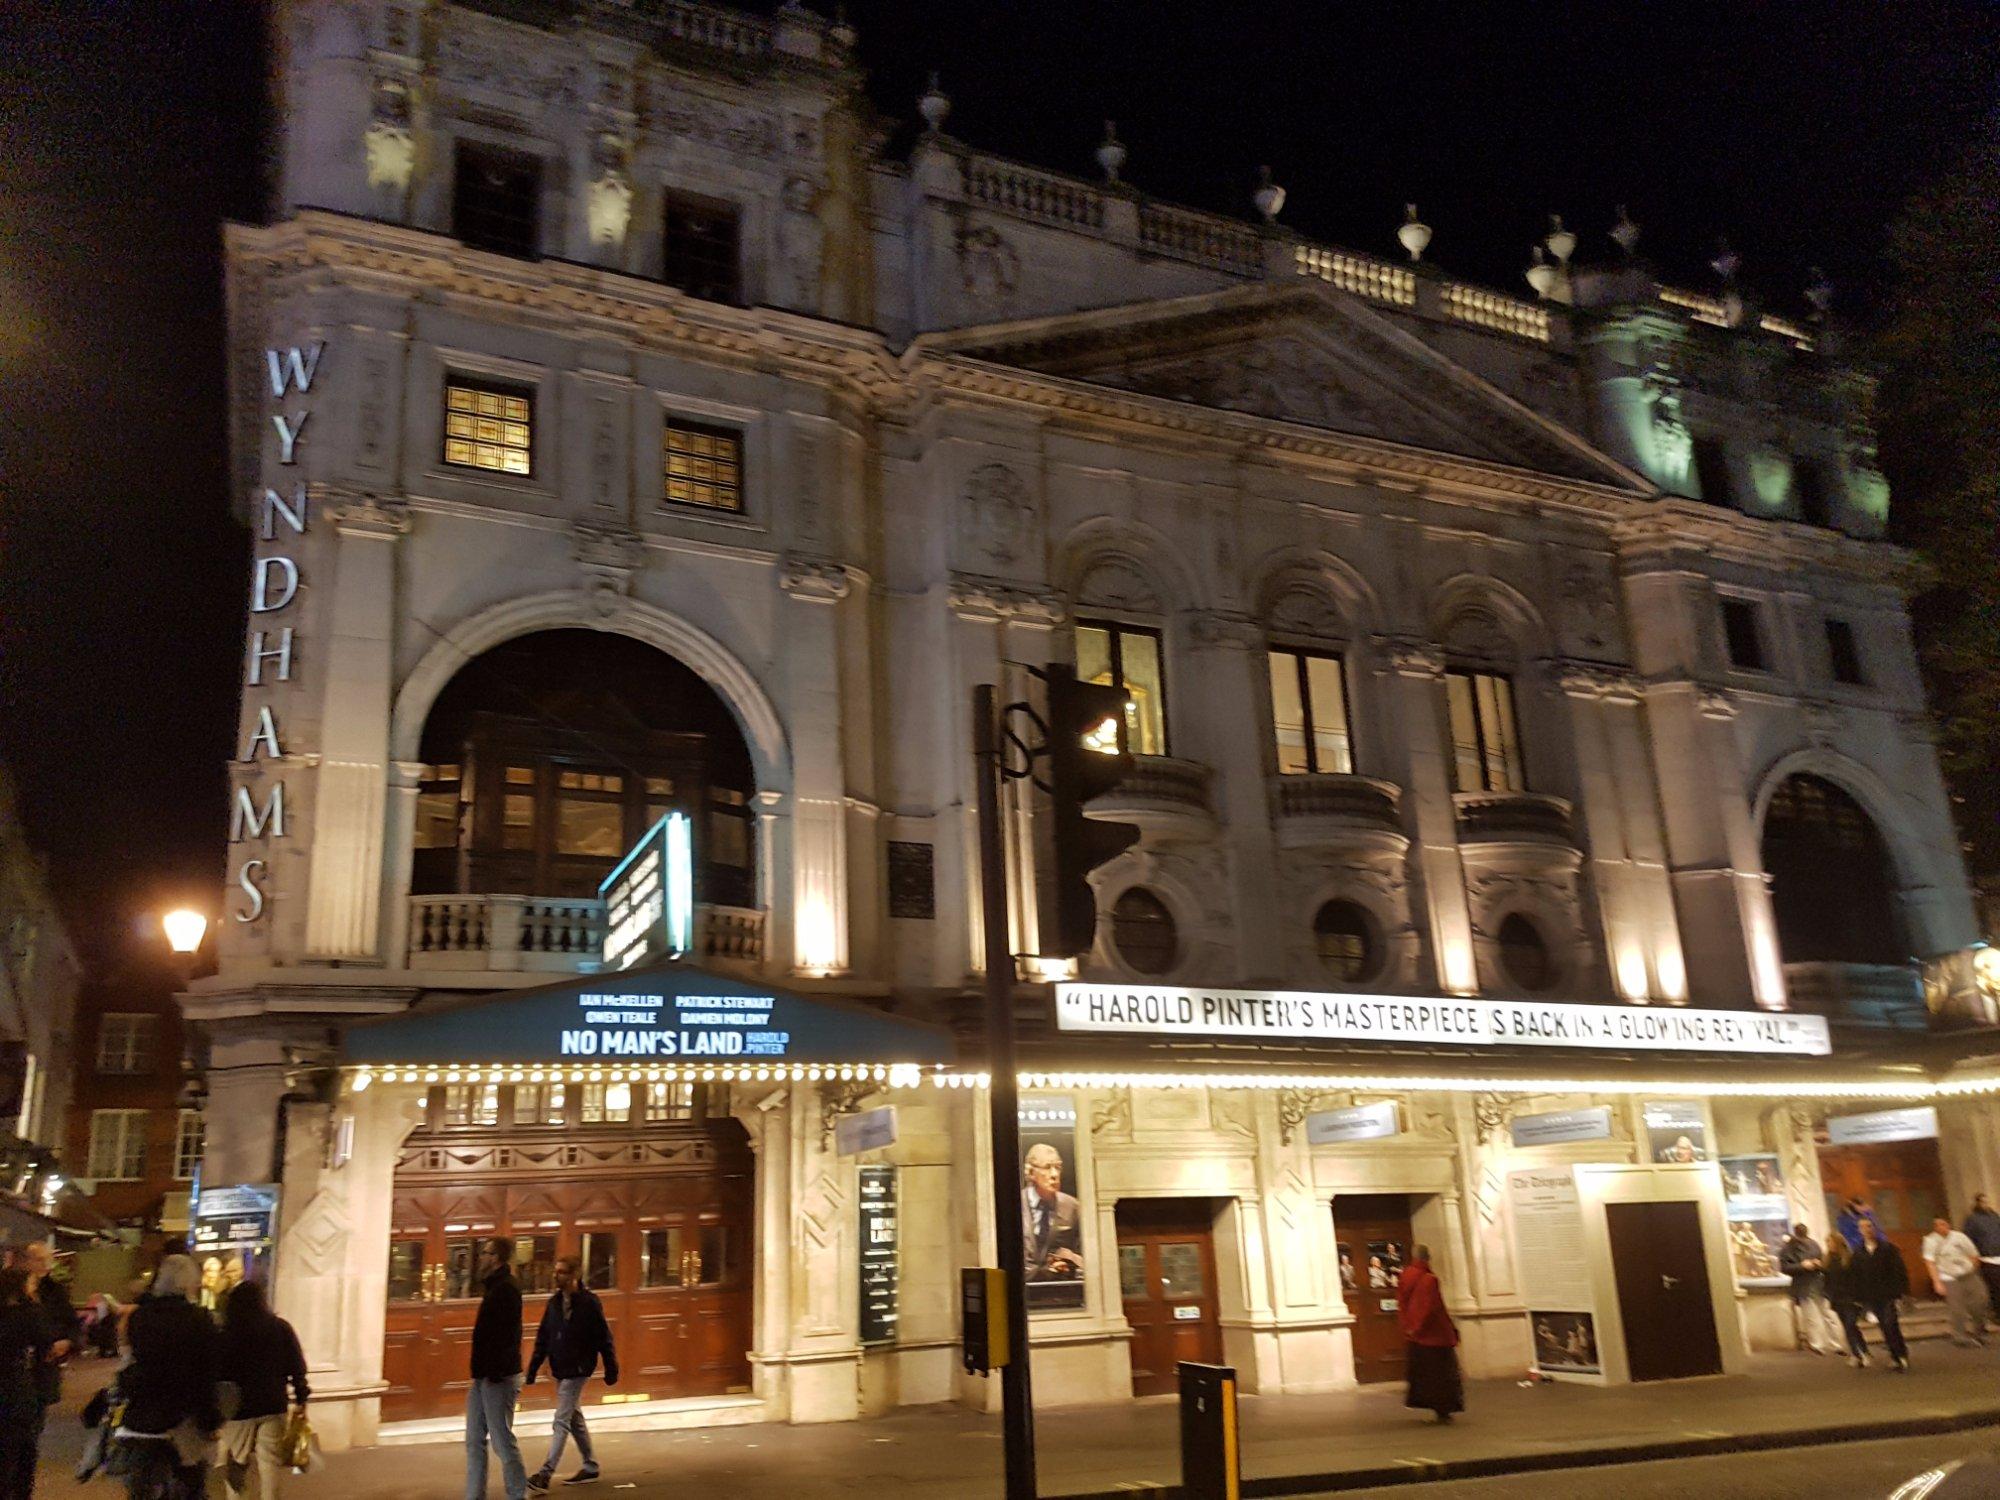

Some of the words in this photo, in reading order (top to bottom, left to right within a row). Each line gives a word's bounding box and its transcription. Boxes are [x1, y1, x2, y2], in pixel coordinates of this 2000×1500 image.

[724, 997, 775, 1009] STEWART
[1322, 1001, 1480, 1034] MASTERPIECE
[1486, 1008, 1506, 1035] IS
[1512, 1010, 1569, 1037] BACK
[1574, 1013, 1594, 1037] IN
[1603, 1014, 1614, 1038] A
[1619, 1014, 1707, 1041] GLOWING
[561, 1030, 598, 1055] NO
[601, 1030, 677, 1055] MAN'S
